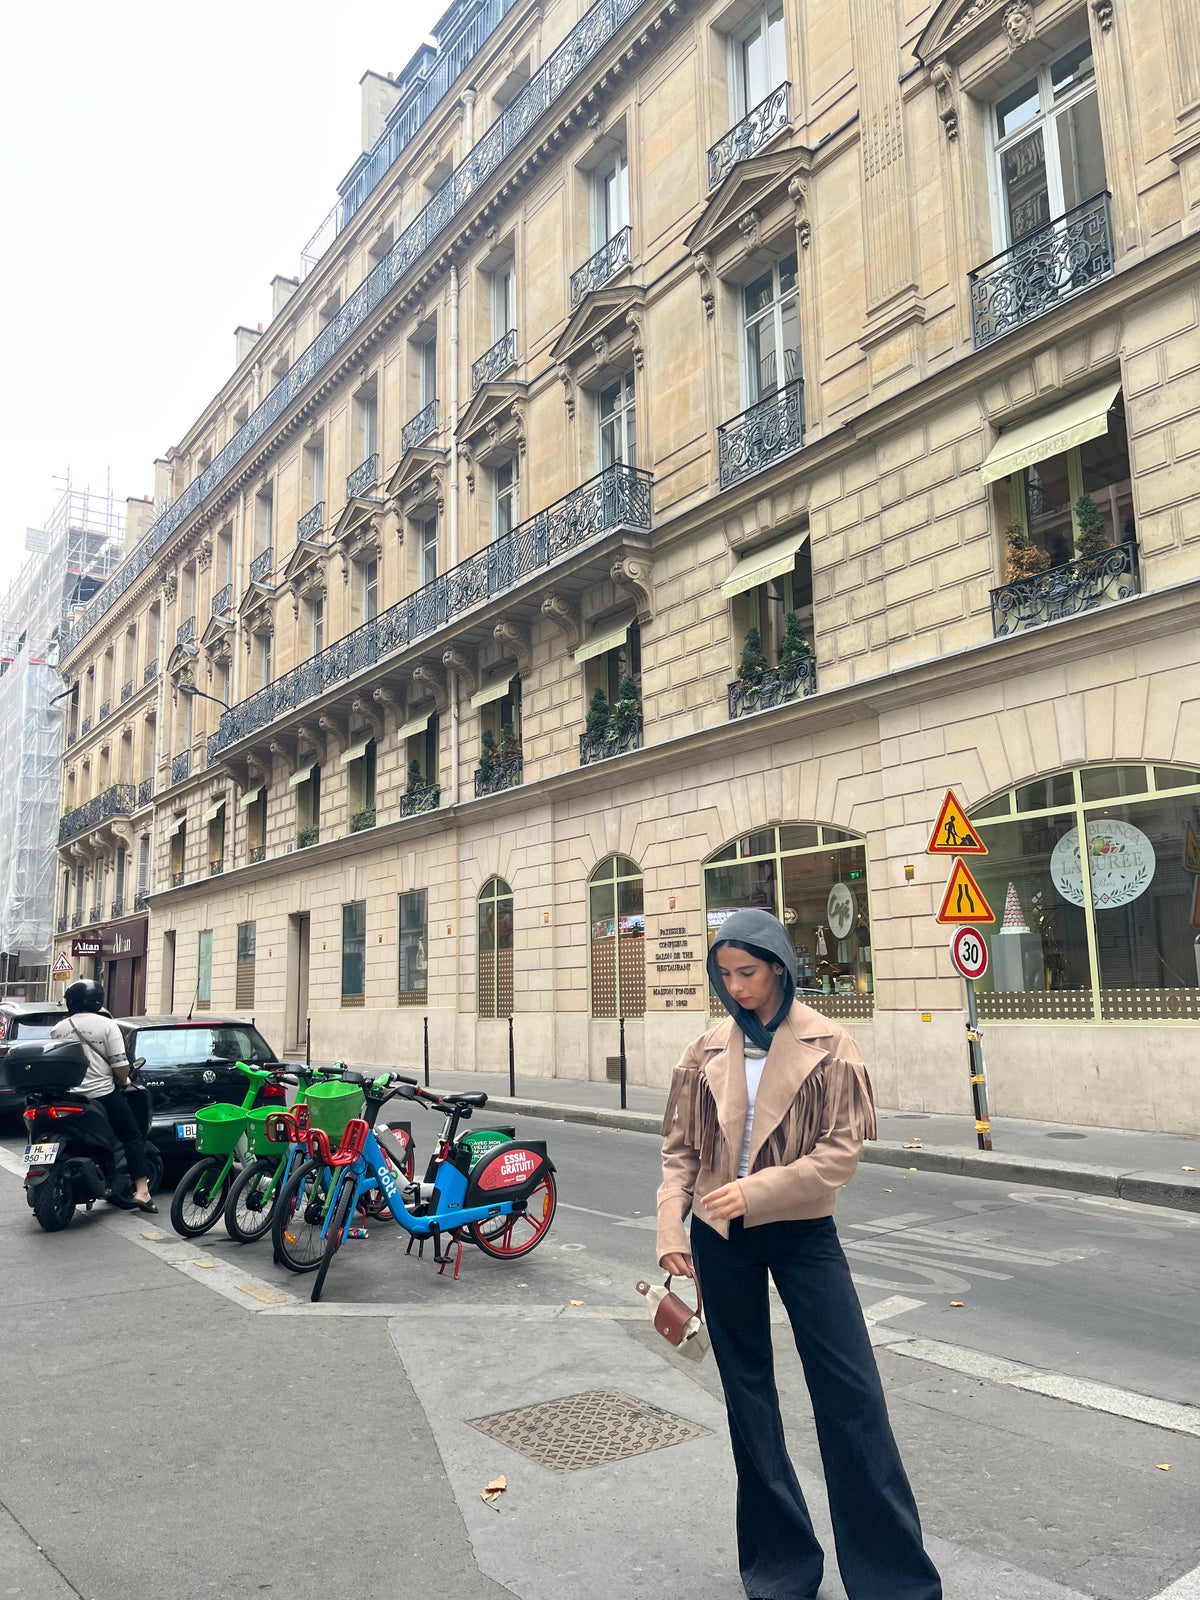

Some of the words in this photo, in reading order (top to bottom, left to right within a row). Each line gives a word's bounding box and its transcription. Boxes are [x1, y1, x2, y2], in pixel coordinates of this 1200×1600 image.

[1058, 823, 1141, 854] CASBLANCA
[74, 943, 100, 951] Altan
[962, 941, 979, 964] 30
[655, 952, 672, 961] SALON
[673, 952, 681, 960] DE
[656, 963, 691, 972] RESTAURANT
[653, 988, 674, 996] MAISON
[504, 1152, 526, 1165] ESSAI
[377, 1166, 397, 1198] dott
